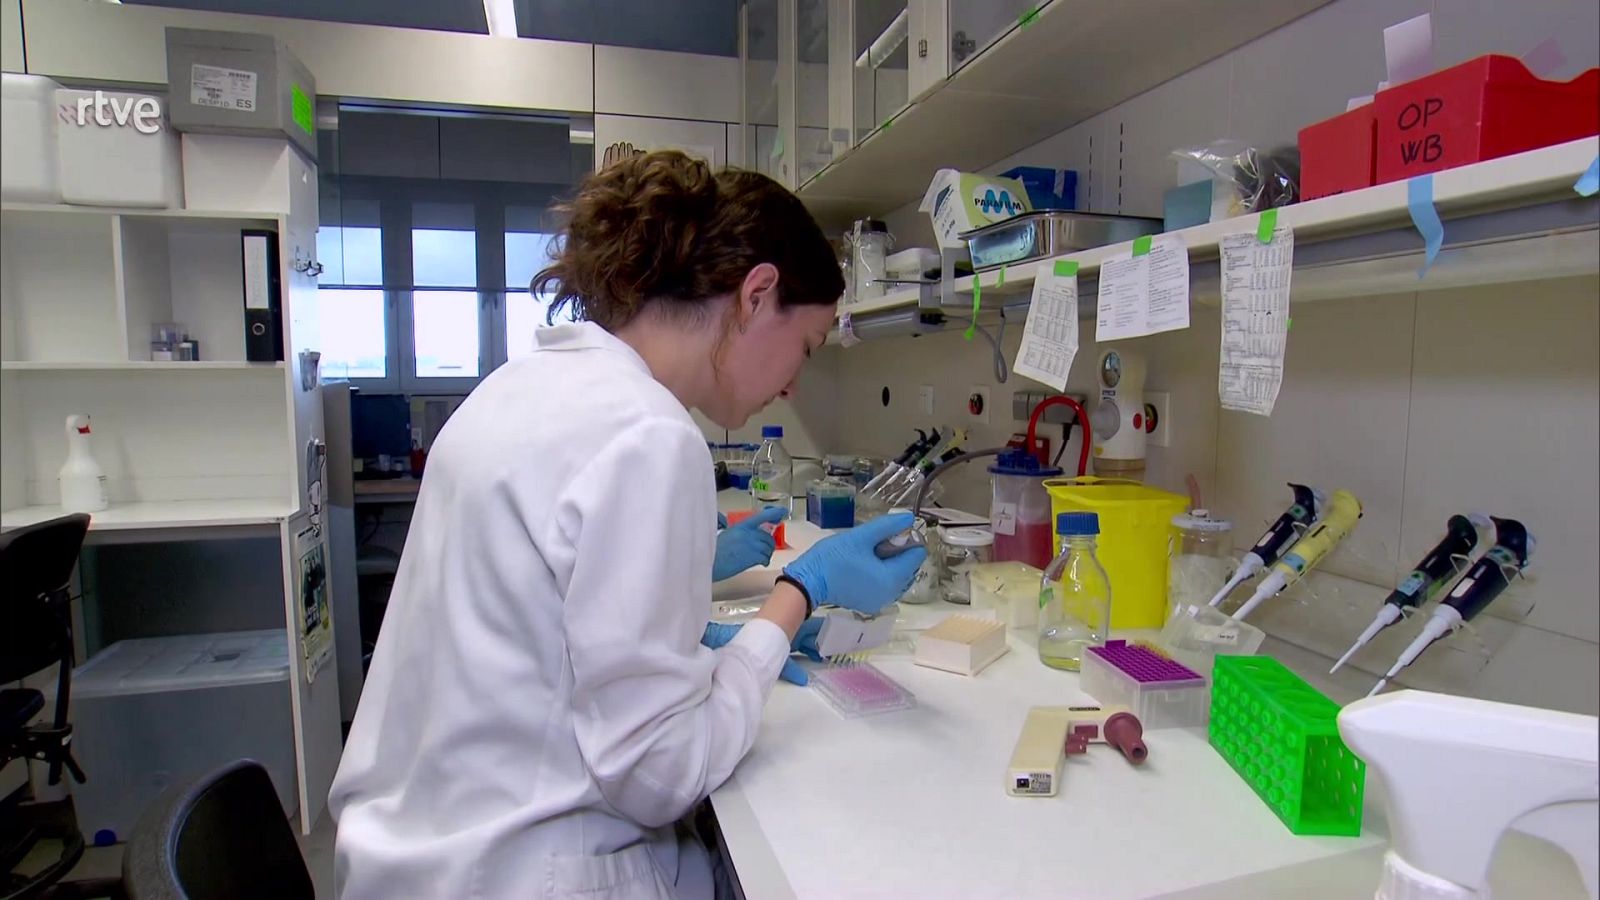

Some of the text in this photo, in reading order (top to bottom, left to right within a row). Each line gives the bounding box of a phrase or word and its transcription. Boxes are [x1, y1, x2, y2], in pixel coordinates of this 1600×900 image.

[236, 98, 252, 108] ES
[1398, 98, 1443, 130] OP
[1401, 134, 1442, 166] WB
[974, 197, 1022, 211] PARAFILM
